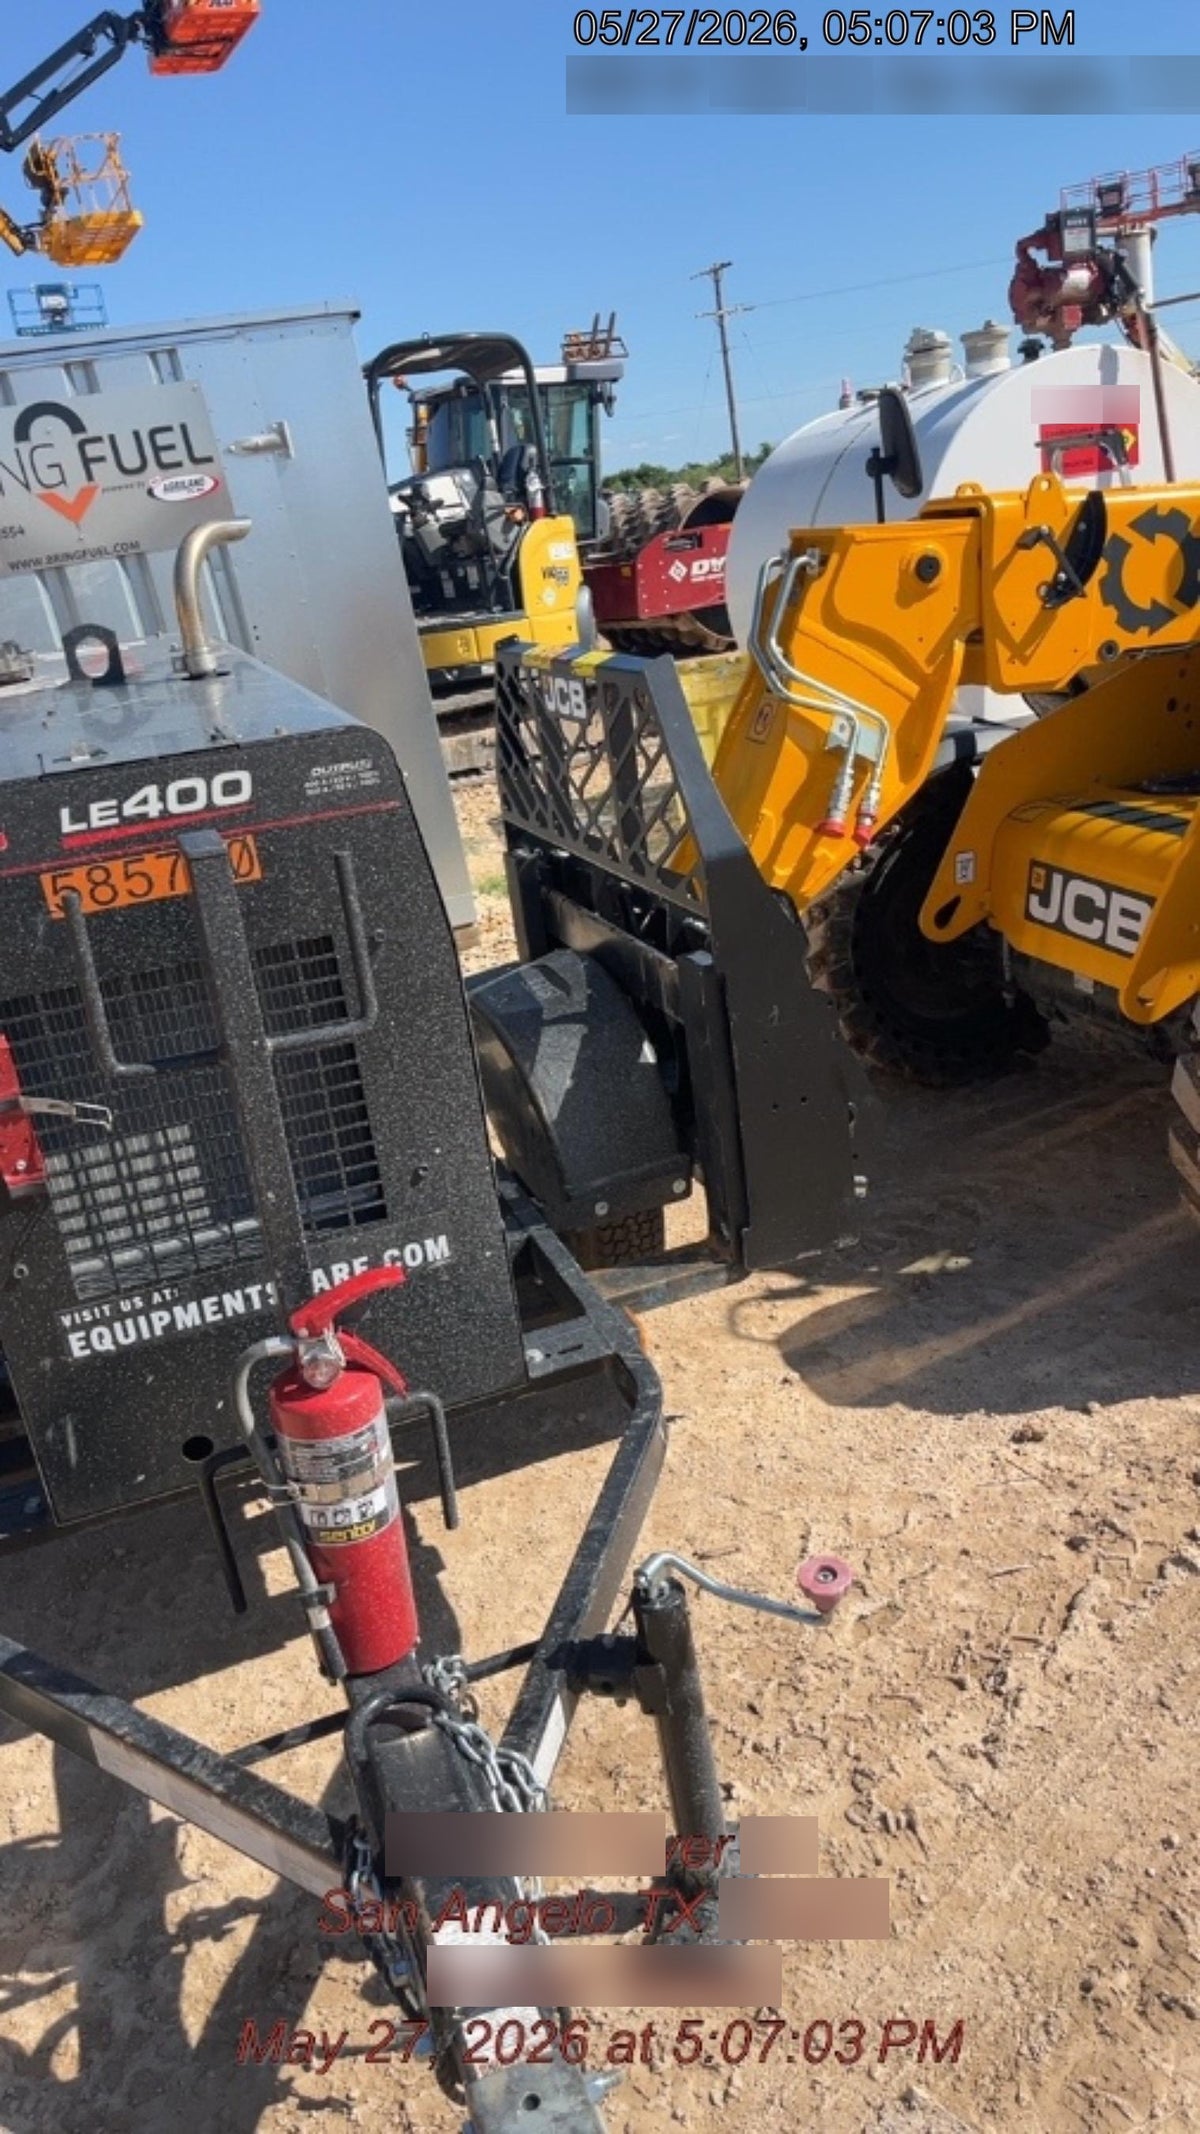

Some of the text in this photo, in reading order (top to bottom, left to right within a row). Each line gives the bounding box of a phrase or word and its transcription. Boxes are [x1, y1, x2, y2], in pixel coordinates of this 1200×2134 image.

[77, 422, 214, 482] FUEL
[543, 676, 587, 719] JCB
[59, 770, 252, 833] LE400
[50, 839, 255, 914] 58570
[1028, 871, 1153, 954] JCB
[61, 1303, 111, 1328] VISIT
[119, 1296, 144, 1313] US
